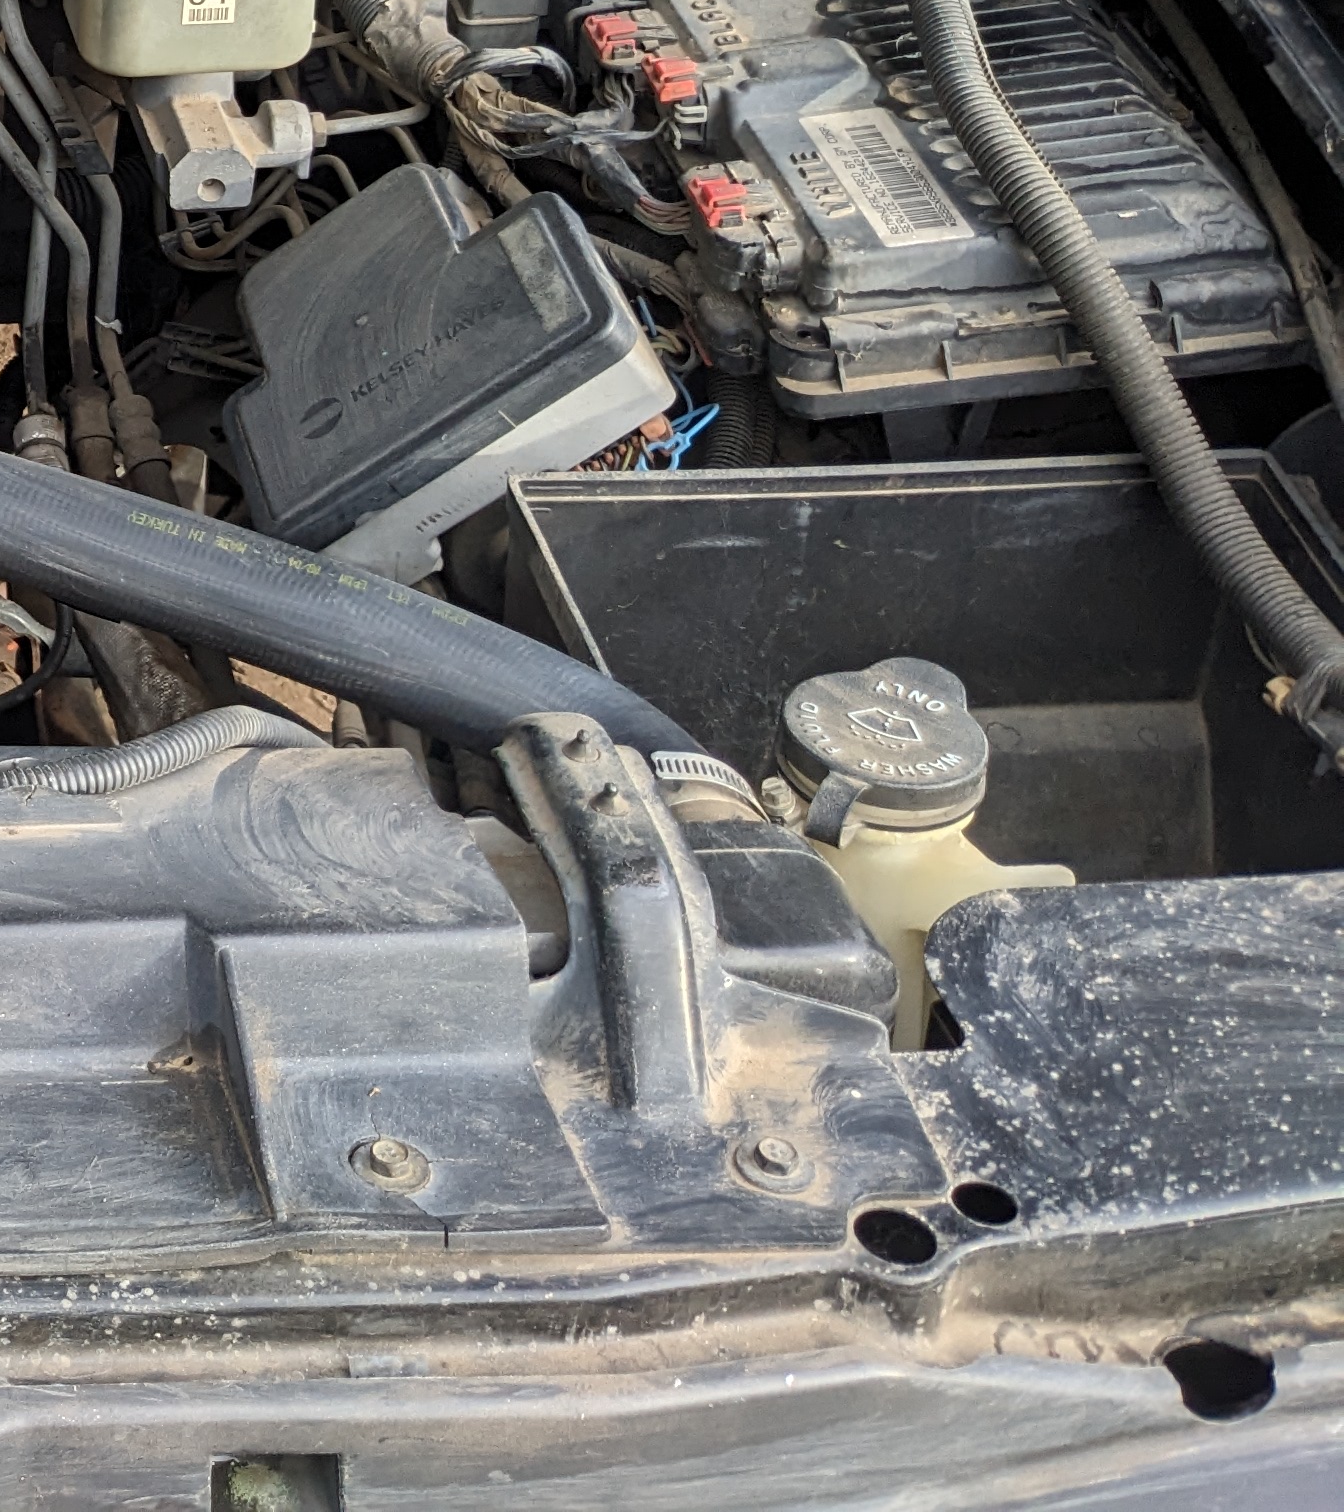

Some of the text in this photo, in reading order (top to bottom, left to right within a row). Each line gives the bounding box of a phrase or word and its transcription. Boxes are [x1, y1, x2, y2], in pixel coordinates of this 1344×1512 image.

[127, 510, 181, 536] TURKEY
[187, 527, 207, 543] IN
[799, 680, 963, 777] WASHER FLUID ONLY
